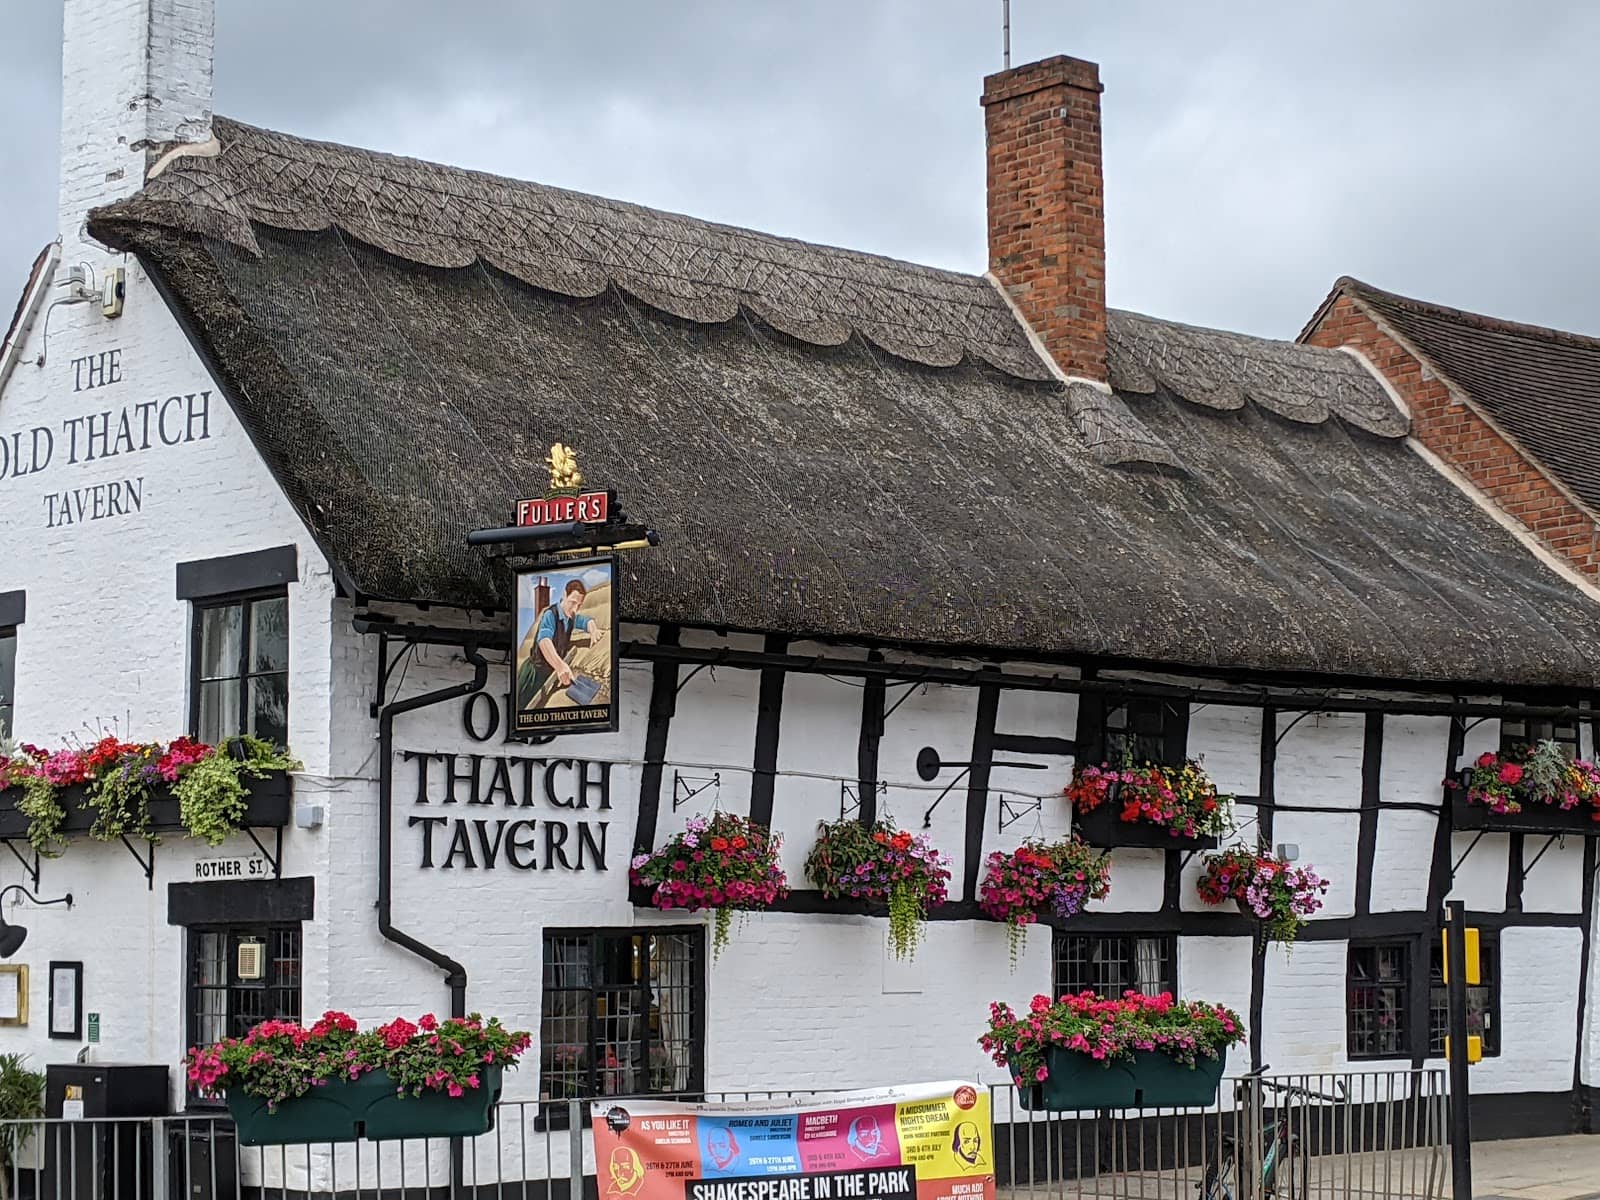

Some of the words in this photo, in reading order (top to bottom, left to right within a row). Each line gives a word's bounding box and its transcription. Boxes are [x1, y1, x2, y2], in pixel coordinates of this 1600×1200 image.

[71, 348, 122, 392] THE
[63, 390, 213, 465] THATCH
[43, 477, 144, 529] TAVERN
[520, 496, 601, 525] FULLER'S
[519, 714, 534, 724] THE
[534, 712, 550, 722] OLD
[550, 711, 579, 721] THATCH
[580, 708, 609, 719] TAVERN
[404, 751, 614, 809] THATCH
[408, 816, 610, 871] TAVERN
[195, 861, 242, 877] ROTHER
[900, 1107, 905, 1115] A
[905, 1103, 947, 1115] MIDSUMMER
[641, 1121, 650, 1130] AS
[651, 1120, 665, 1130] YOU
[666, 1120, 682, 1130] LIKE
[682, 1120, 690, 1130] IT
[728, 1119, 753, 1128] ROMEO
[754, 1119, 769, 1127] AND
[770, 1118, 793, 1127] JULIET
[805, 1114, 838, 1126] MACBETH
[900, 1115, 925, 1127] NIGHTS
[925, 1112, 950, 1123] DREAM
[680, 1161, 694, 1169] JUNE
[693, 1178, 811, 1200] SHAKESPEARE
[814, 1176, 831, 1199] IN
[834, 1173, 866, 1198] THE
[868, 1170, 910, 1195] PARK
[951, 1184, 971, 1195] MUCH
[971, 1183, 984, 1194] ADO
